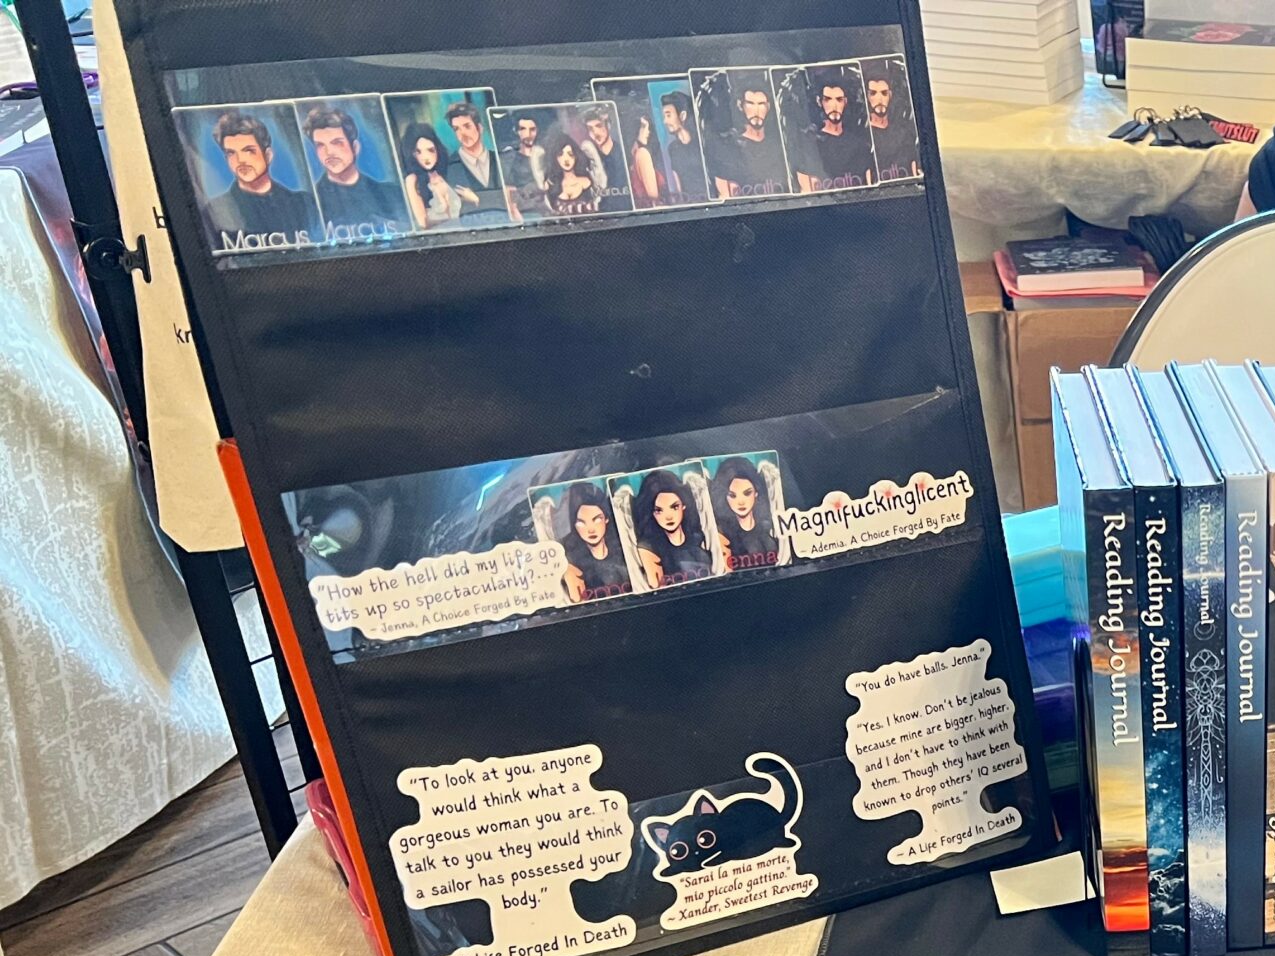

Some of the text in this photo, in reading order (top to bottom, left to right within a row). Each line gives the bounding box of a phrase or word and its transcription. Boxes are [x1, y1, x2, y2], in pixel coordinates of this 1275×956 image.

[222, 229, 311, 249] Marcus
[777, 475, 970, 537] Magnifuckinglicent
[850, 513, 961, 545] A Choice Forged By Fate
[1195, 503, 1214, 565] Reading
[318, 548, 557, 601] "How the hell did my life go
[326, 607, 360, 624] tits
[365, 601, 388, 620] up
[393, 597, 410, 611] so
[421, 591, 556, 625] A Choice Forged By Fate
[1098, 511, 1139, 746] Reading Journal
[1140, 517, 1178, 732] Reading Journal
[1231, 510, 1263, 723] Reading Journal
[856, 670, 921, 692] "You do have
[886, 685, 1001, 726] I know. Don't be jealous
[855, 724, 943, 755] because mine are
[865, 721, 1009, 773] and I don't have to think with
[410, 776, 440, 792] "To
[445, 769, 475, 788] look
[482, 767, 500, 781] at
[542, 753, 592, 774] anyone
[863, 755, 1023, 811] known to drop IQ several
[871, 741, 1010, 790] them. Though they have been
[431, 781, 580, 816] would think what a
[400, 798, 619, 853] gorgeous woman you are. To
[908, 814, 1016, 857] A Life Forged In Death
[405, 822, 624, 874] talk to you they would think
[718, 855, 790, 879] la mia morte,
[416, 850, 622, 899] a sailor has possessed your
[684, 879, 743, 904] mio piccolo
[502, 886, 548, 909] body."
[679, 879, 813, 921] Xander, Sweetest Revenge
[564, 934, 579, 948] In
[583, 923, 628, 943] Death
